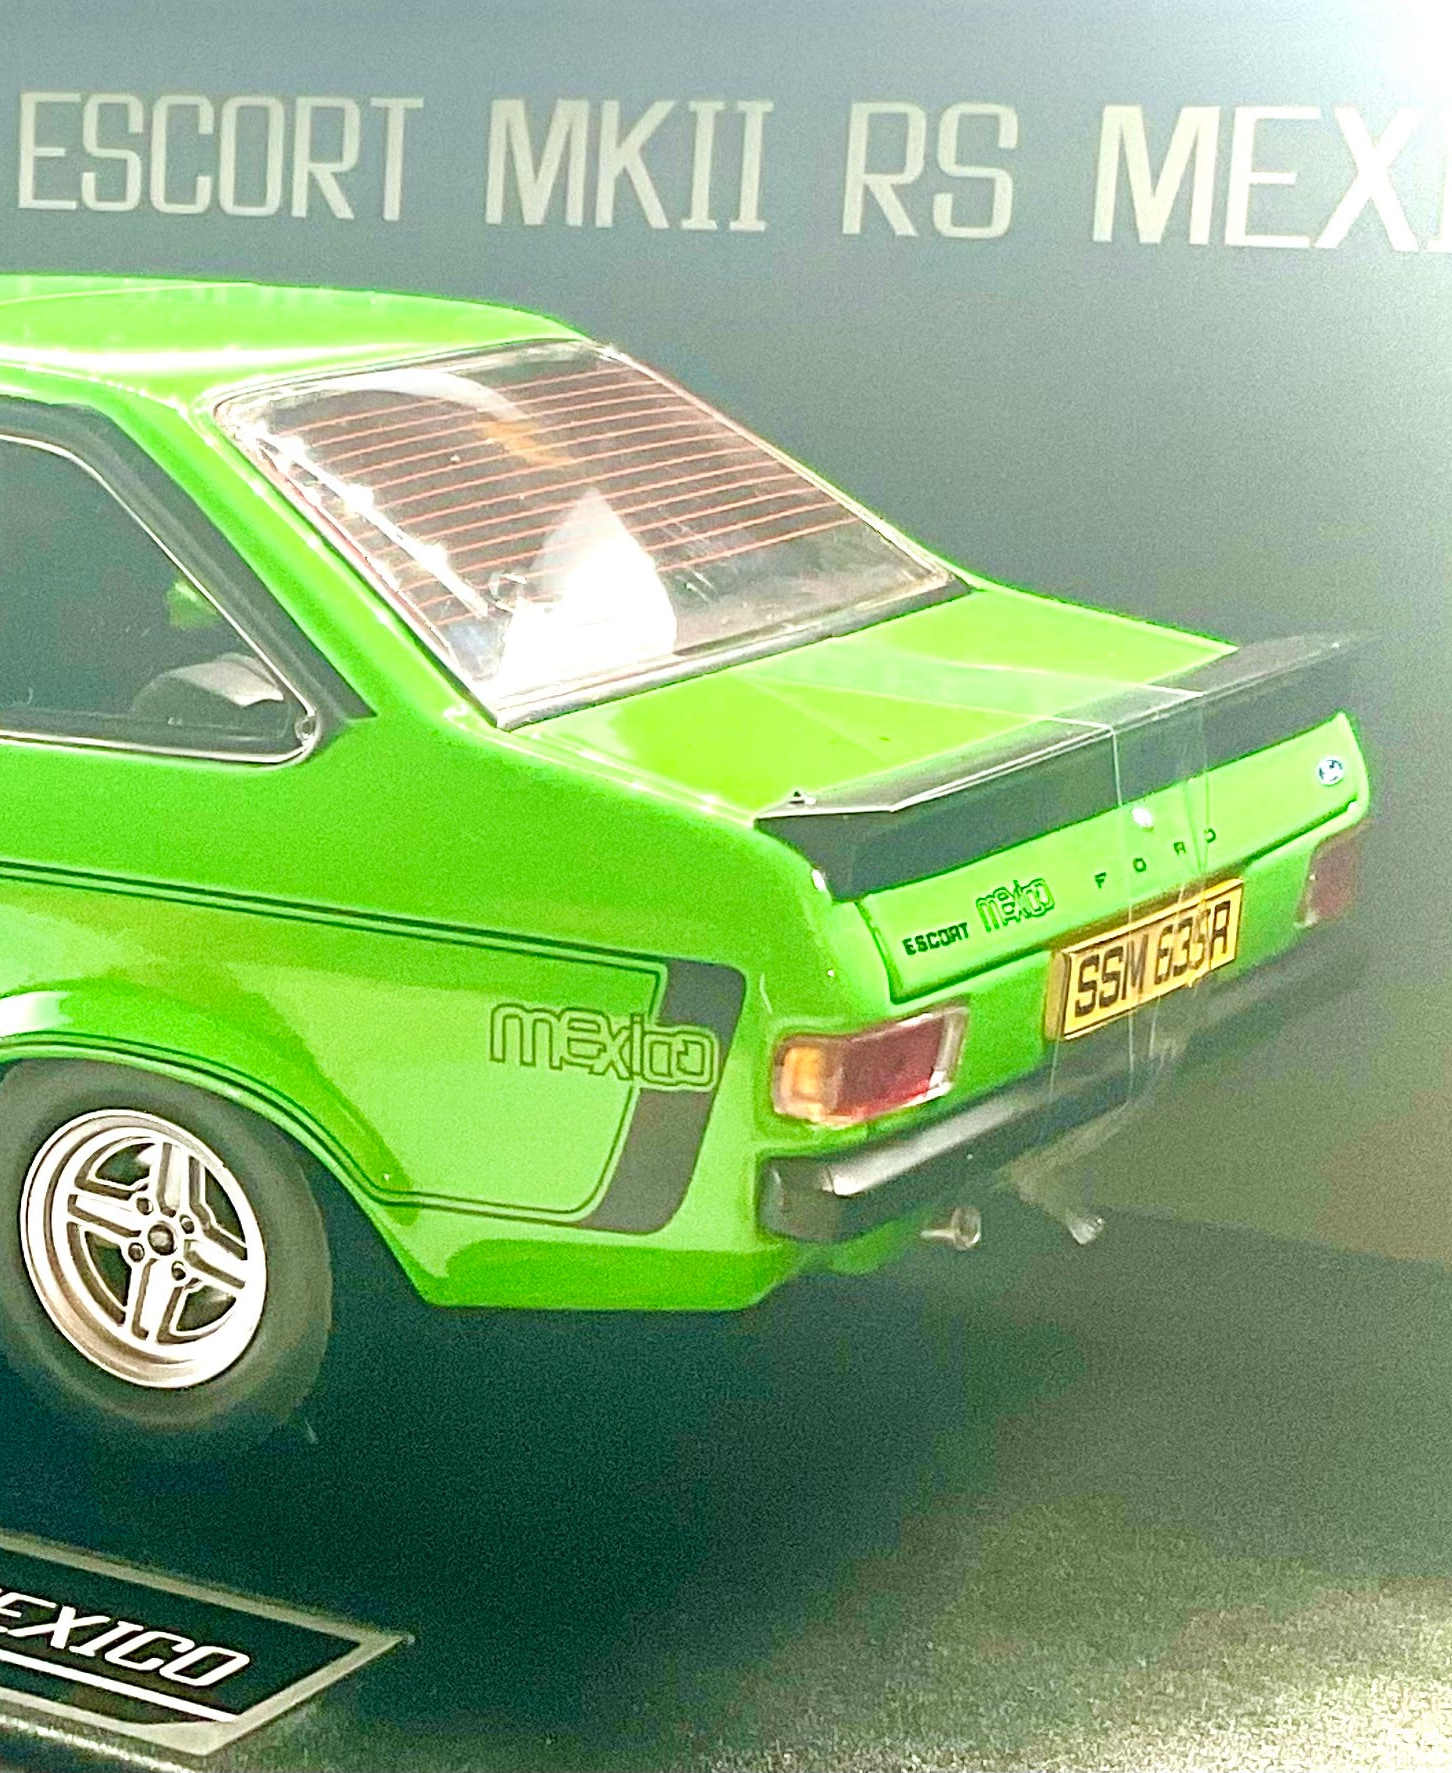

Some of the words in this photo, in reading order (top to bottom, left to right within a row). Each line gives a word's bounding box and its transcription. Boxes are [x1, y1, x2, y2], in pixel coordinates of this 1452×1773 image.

[16, 91, 425, 221] ESCORT
[484, 97, 774, 232] MKII
[840, 101, 1018, 240] RS
[901, 921, 970, 956] ESCORT
[1074, 933, 1149, 1018] SSM
